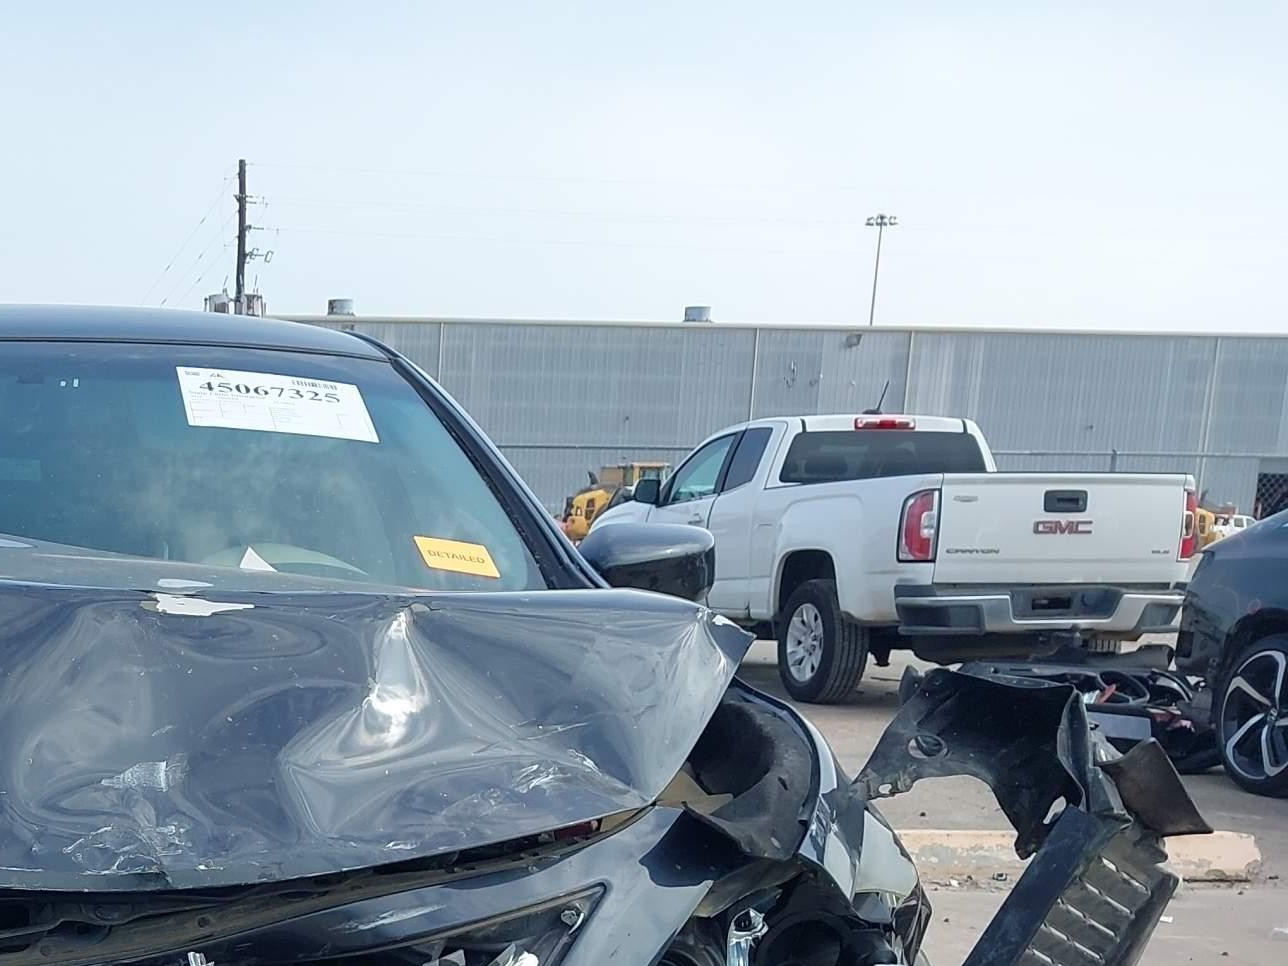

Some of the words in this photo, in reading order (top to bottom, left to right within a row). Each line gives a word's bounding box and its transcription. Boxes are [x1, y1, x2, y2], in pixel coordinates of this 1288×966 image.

[199, 381, 341, 404] 45067325
[1032, 520, 1093, 535] GMC
[427, 549, 485, 565] DETAILED
